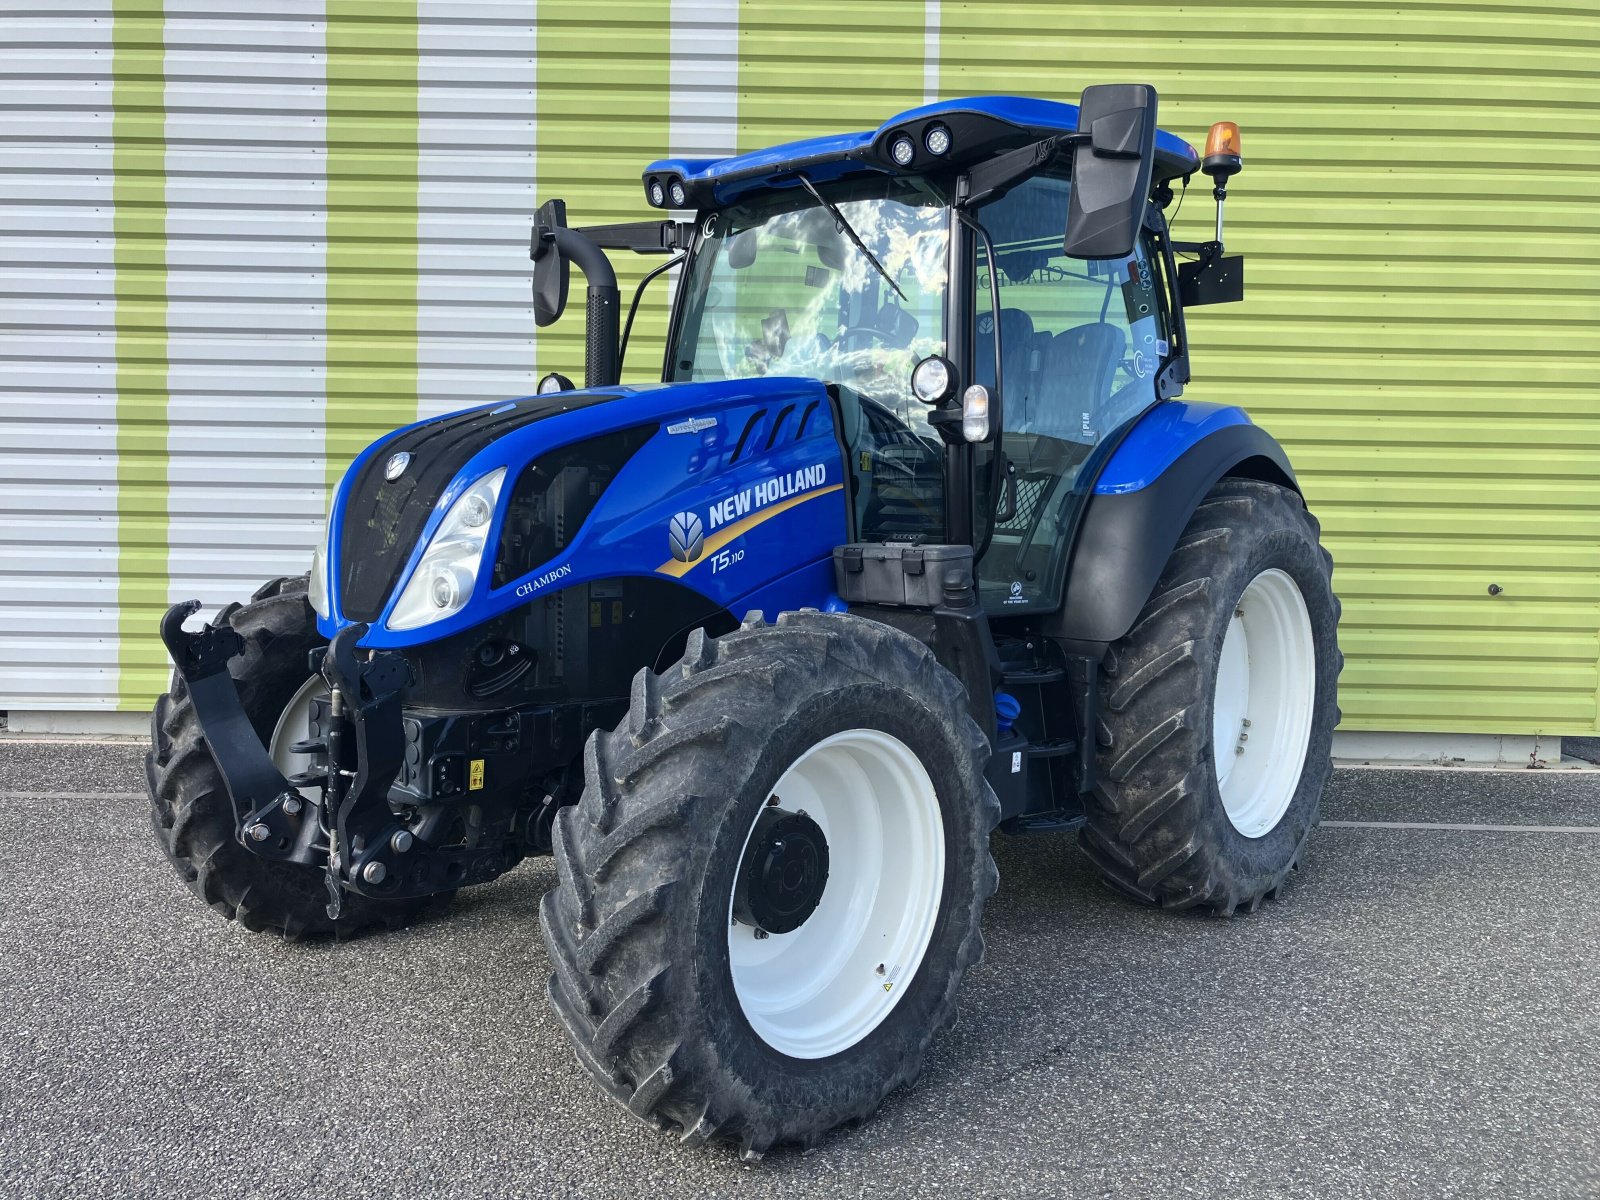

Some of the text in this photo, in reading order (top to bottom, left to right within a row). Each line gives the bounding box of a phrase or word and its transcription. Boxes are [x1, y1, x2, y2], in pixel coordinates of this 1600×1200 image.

[709, 463, 826, 529] NEW HOLLAND
[515, 563, 572, 597] CHAMBON
